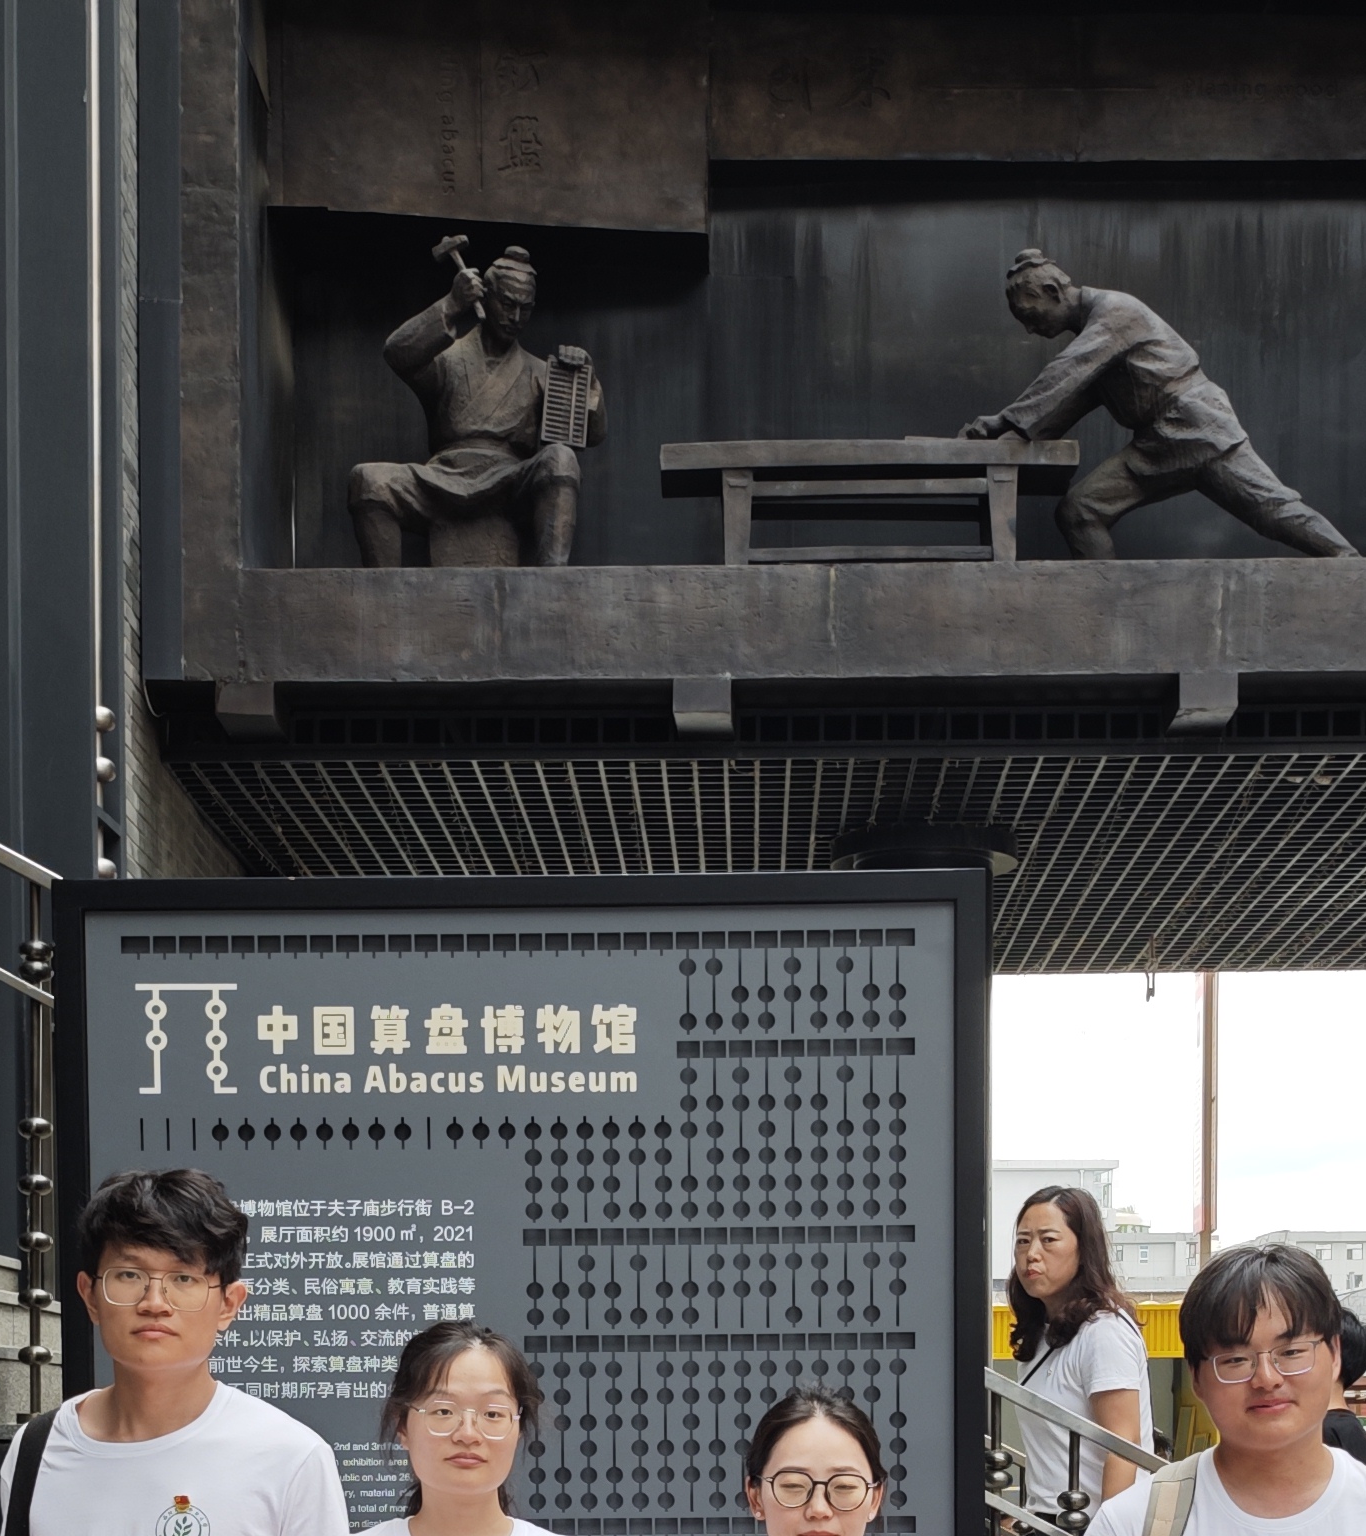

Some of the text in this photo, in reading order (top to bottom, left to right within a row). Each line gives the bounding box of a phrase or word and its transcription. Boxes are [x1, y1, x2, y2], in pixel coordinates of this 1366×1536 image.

[257, 1003, 637, 1056] 中国算盘博物馆
[259, 1062, 638, 1094] China Abacus Museum
[232, 1199, 433, 1218] 博物馆位于夫子庙步行街
[213, 1328, 426, 1348] 余件。以保护、弘扬、交流的
[228, 1381, 392, 1400] 同时期所孕育出的
